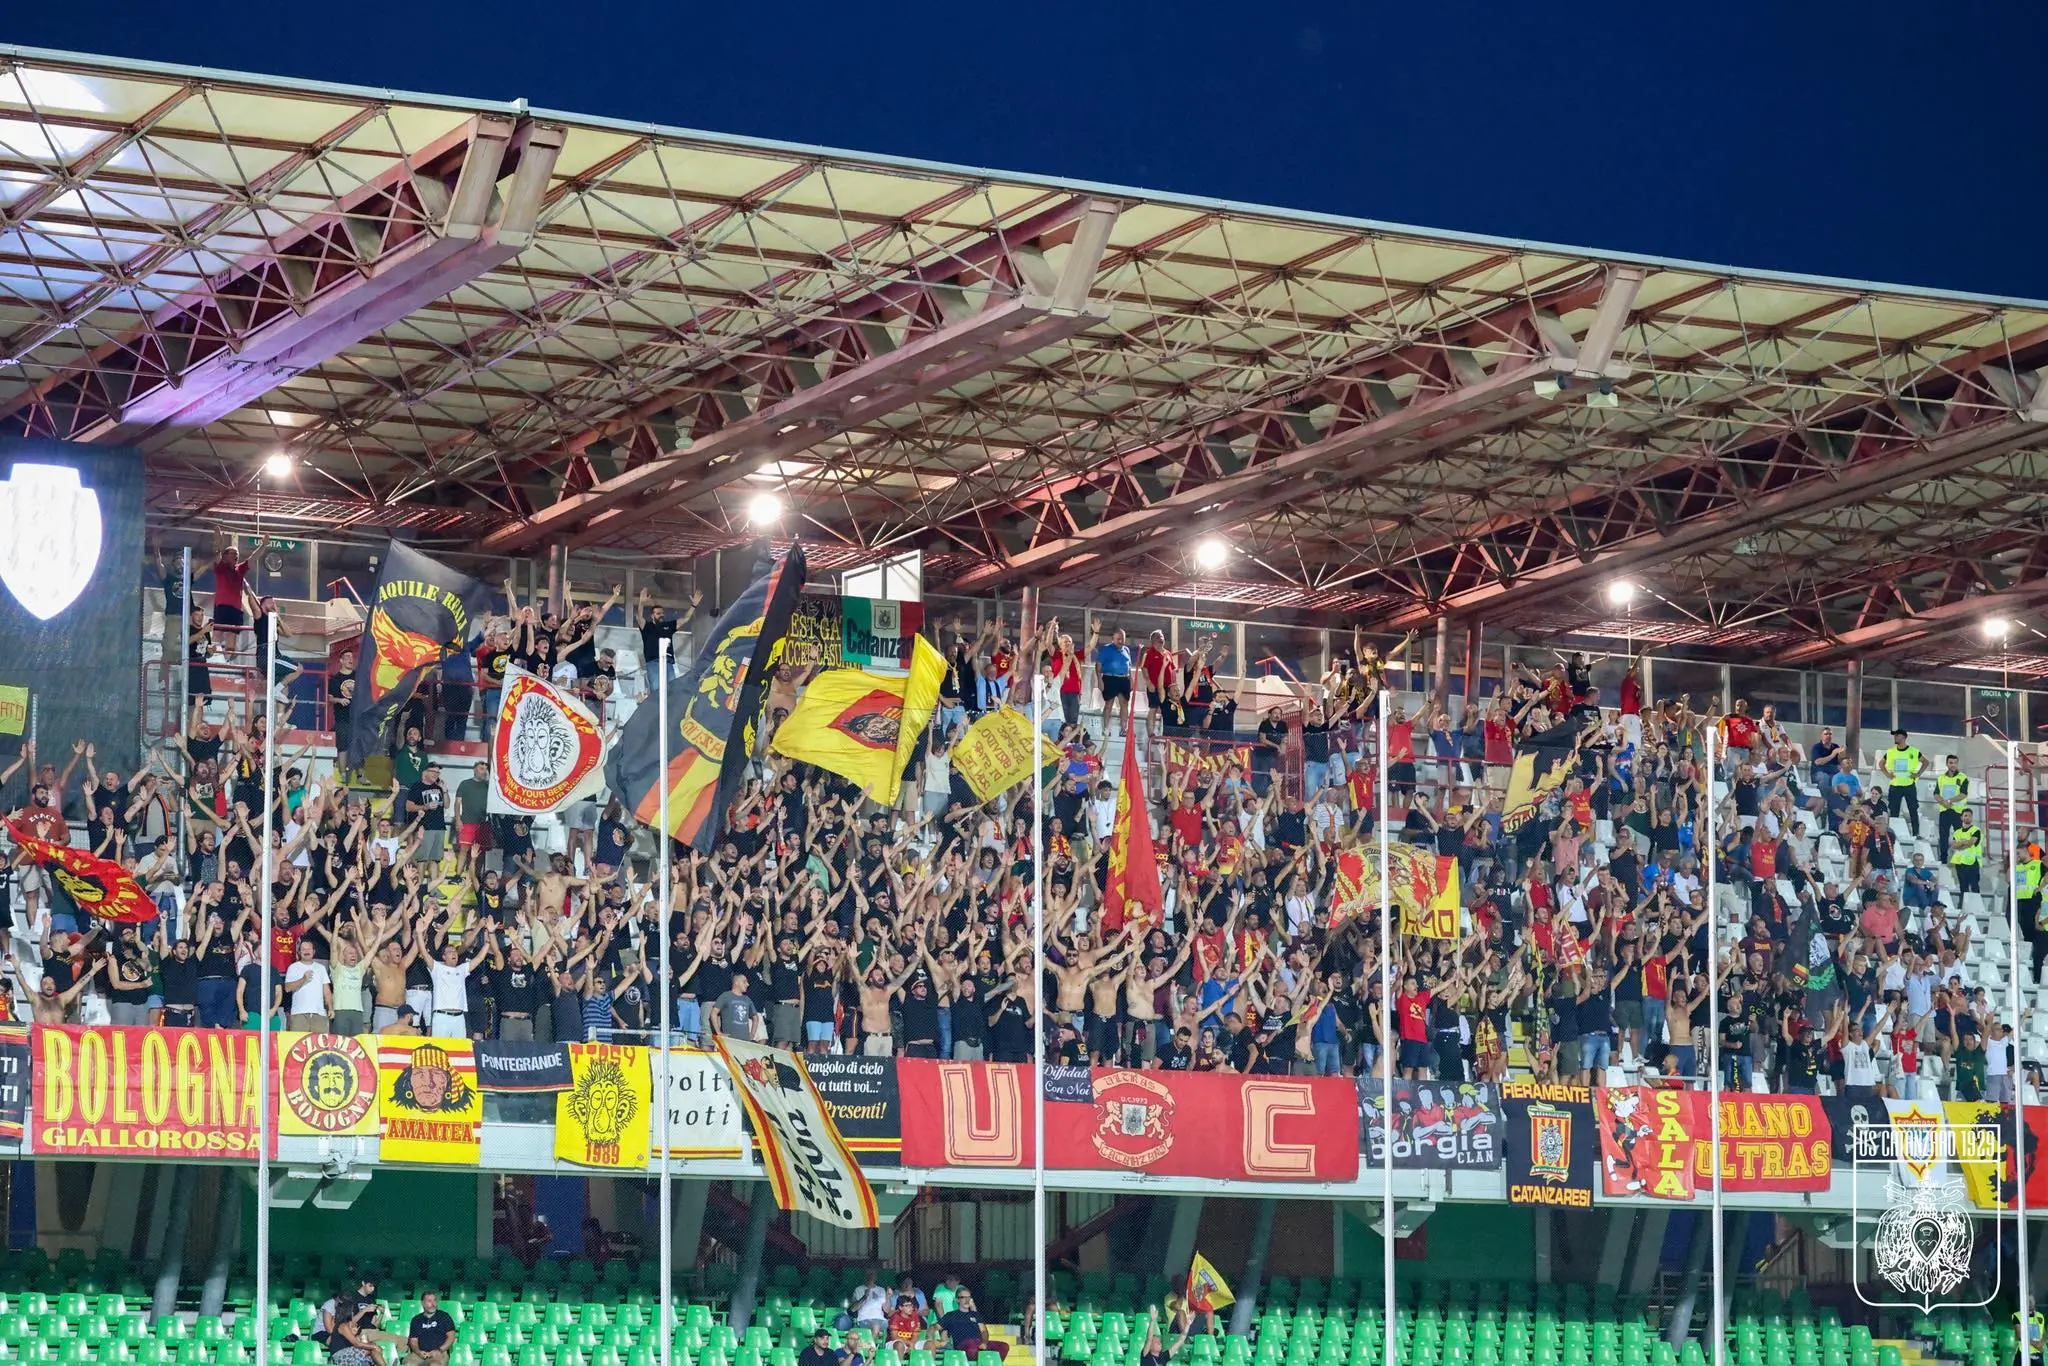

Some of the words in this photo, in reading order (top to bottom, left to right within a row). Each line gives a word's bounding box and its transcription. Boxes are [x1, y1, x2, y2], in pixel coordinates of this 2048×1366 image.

[254, 538, 282, 548] USITA
[379, 580, 440, 603] AQUILE
[1190, 620, 1214, 629] USCITA
[514, 793, 537, 807] FUCK
[521, 787, 546, 798] YOUR
[291, 1033, 366, 1063] CZCMP
[481, 1053, 563, 1072] PONTEGRANDE
[847, 1061, 858, 1074] di
[859, 1062, 884, 1075] cielo
[43, 1028, 261, 1128] BOLOGNA
[818, 1082, 827, 1092] a
[828, 1080, 852, 1092] tutti
[1045, 1080, 1064, 1094] Con
[1066, 1082, 1091, 1096] Noi
[1502, 1082, 1590, 1104] FIERAMENTE
[287, 1088, 374, 1130] BOLOGNA
[824, 1101, 888, 1121] Presenti!
[938, 1064, 1022, 1167] U
[1241, 1080, 1316, 1176] C
[42, 1127, 261, 1151] GIALLOROSSA
[388, 1118, 474, 1143] AMANTEA
[585, 1143, 621, 1165] 1989
[1654, 1090, 1690, 1196] SALA
[1457, 1150, 1495, 1164] CLAN
[1695, 1140, 1831, 1180] ULTRAS
[1510, 1185, 1591, 1207] CATANZARESI
